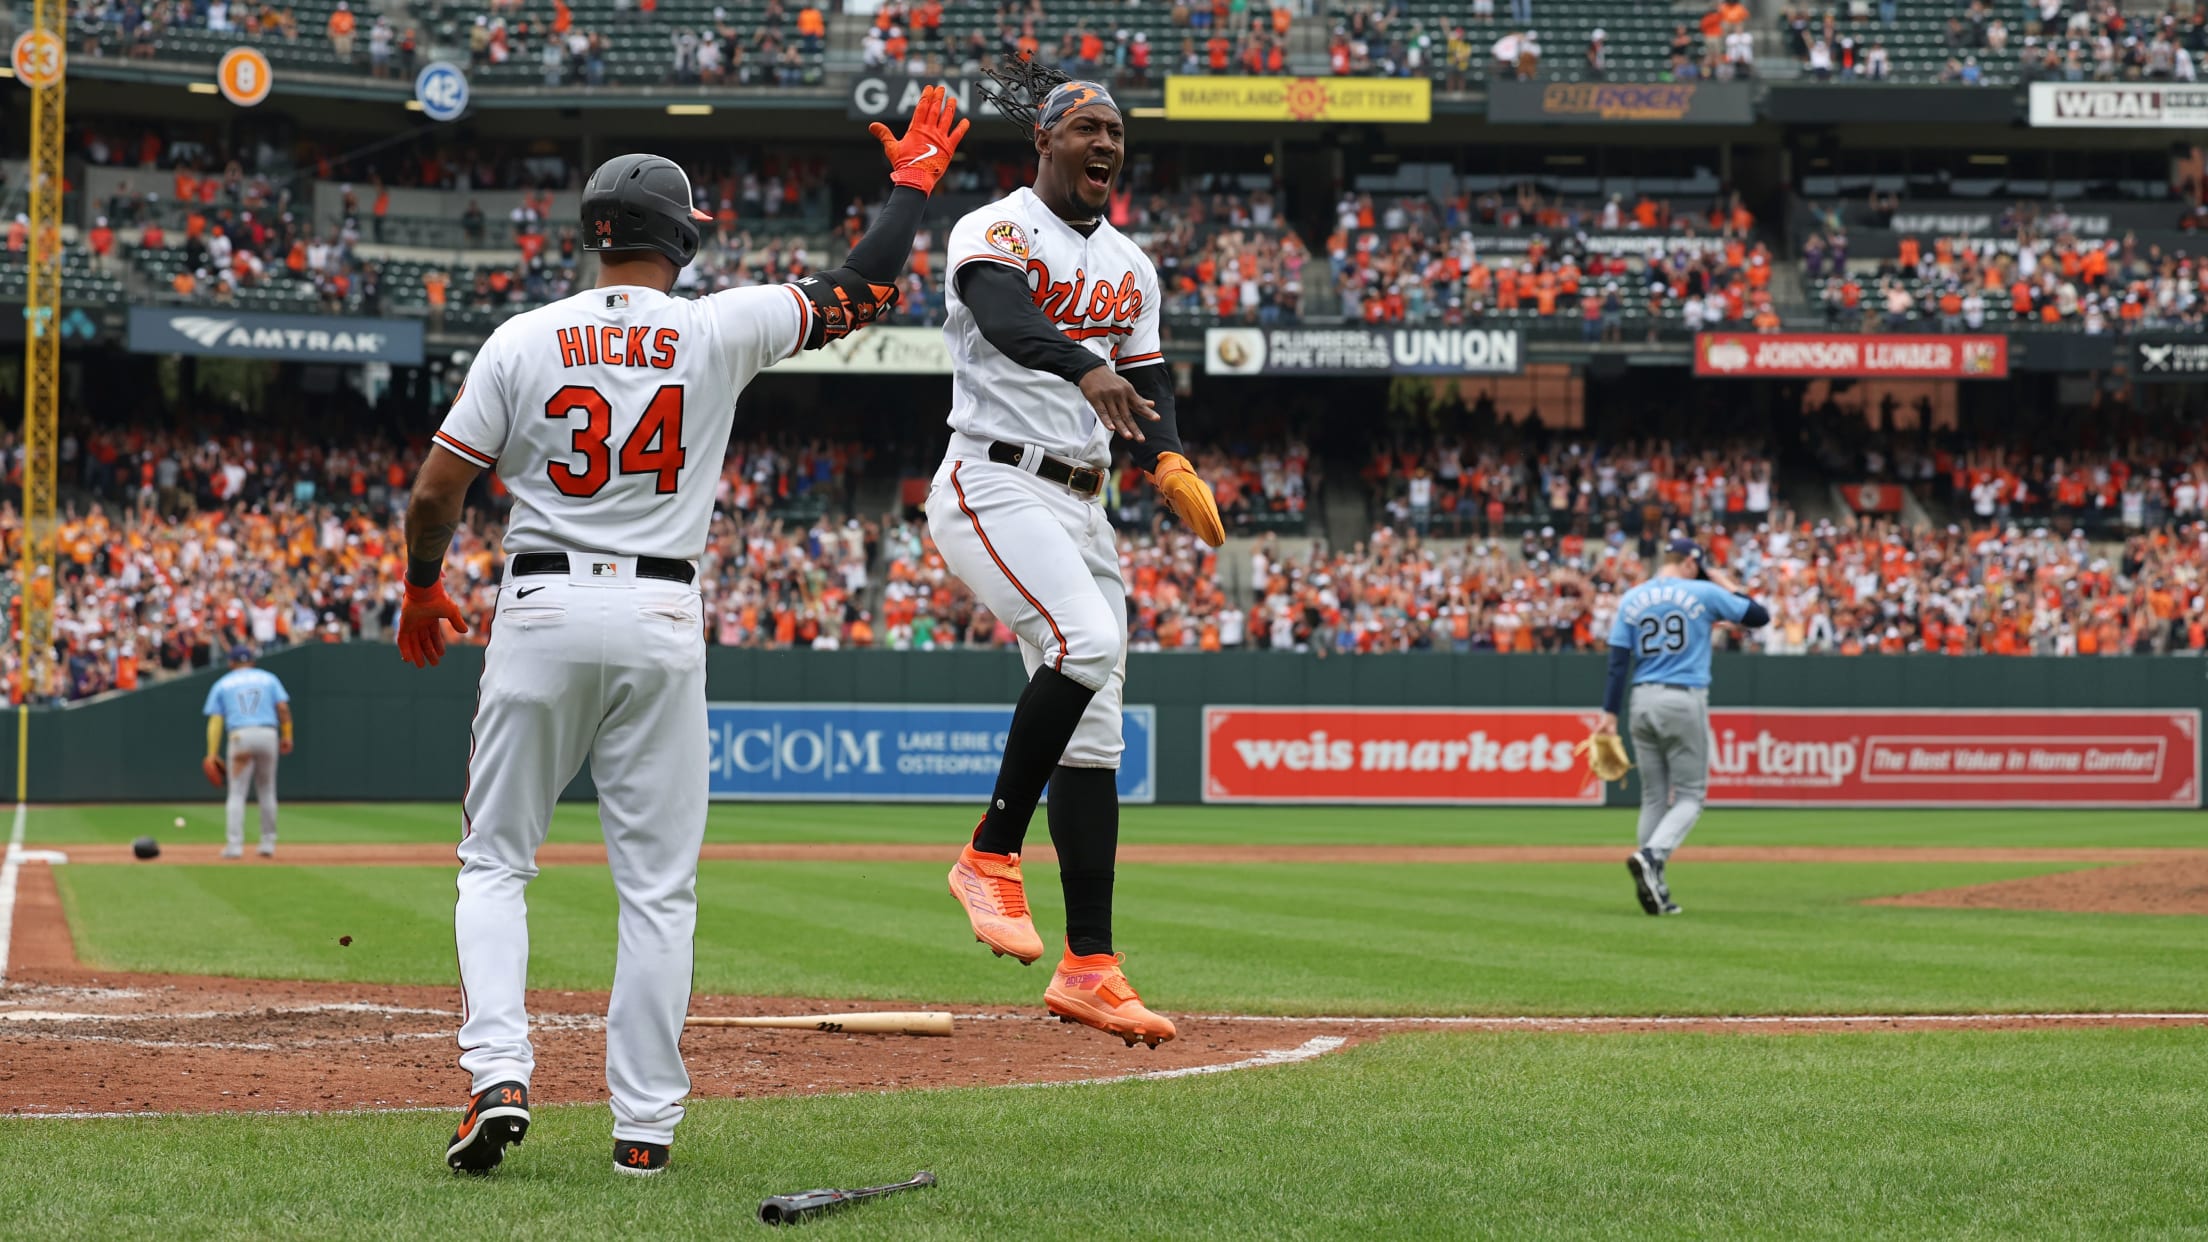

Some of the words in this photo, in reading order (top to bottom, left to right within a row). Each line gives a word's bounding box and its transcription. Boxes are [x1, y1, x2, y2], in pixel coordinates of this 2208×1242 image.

[236, 59, 256, 93] 8
[425, 72, 460, 107] 42
[1179, 88, 1282, 106] MARYLAND
[1330, 89, 1414, 107] LOTTERY
[2058, 90, 2161, 117] WBAL
[594, 220, 612, 236] 34
[227, 325, 380, 352] AMTRAK
[556, 325, 680, 370] HICKS
[1269, 330, 1371, 349] PLUMBERS
[1394, 330, 1517, 365] UNION
[1269, 350, 1312, 368] PIPE
[1316, 350, 1391, 368] FITTERS
[1754, 342, 1858, 368] JOHNSON
[1866, 343, 1952, 368] LUMBER
[545, 384, 686, 498] 34
[1638, 609, 1688, 656] 29
[237, 687, 262, 715] 17
[897, 731, 945, 750] LAKE
[950, 731, 992, 750] ERIE
[1234, 730, 1355, 771] weis
[1359, 730, 1575, 772] markets
[501, 1087, 522, 1105] 34
[628, 1147, 649, 1166] 34
